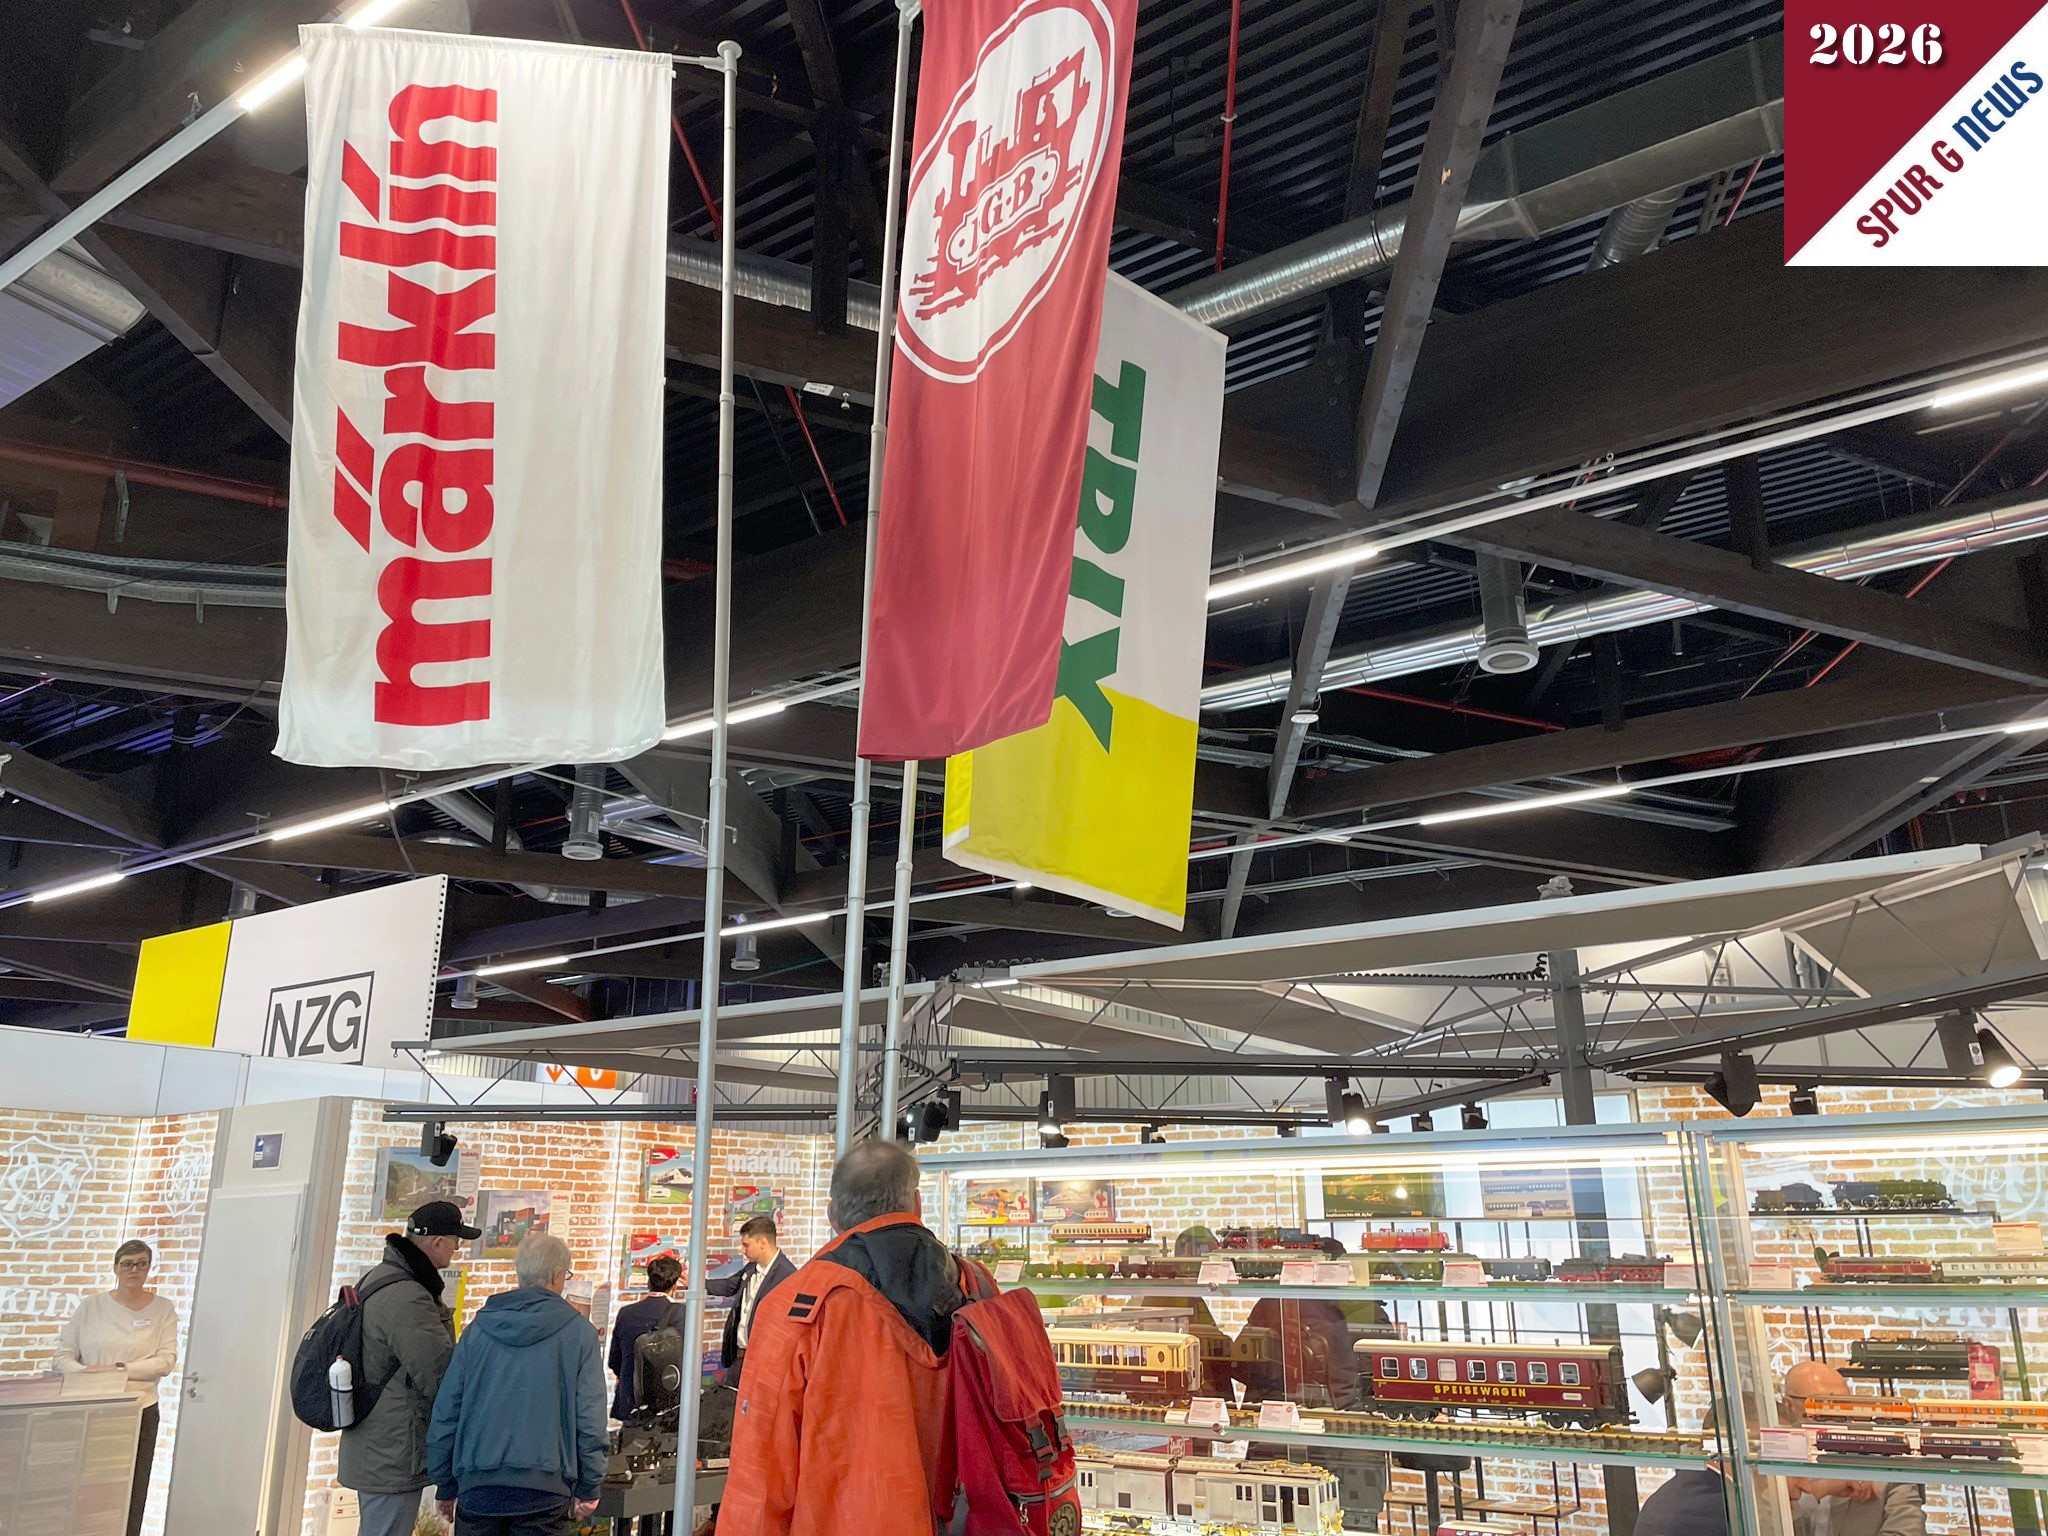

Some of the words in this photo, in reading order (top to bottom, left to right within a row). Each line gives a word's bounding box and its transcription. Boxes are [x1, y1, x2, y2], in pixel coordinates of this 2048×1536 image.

[333, 82, 498, 728] märklin
[271, 990, 362, 1058] NZG
[727, 1149, 801, 1174] märklin
[442, 1270, 463, 1278] TRIX
[1434, 1384, 1527, 1398] SPEISEWAGEN
